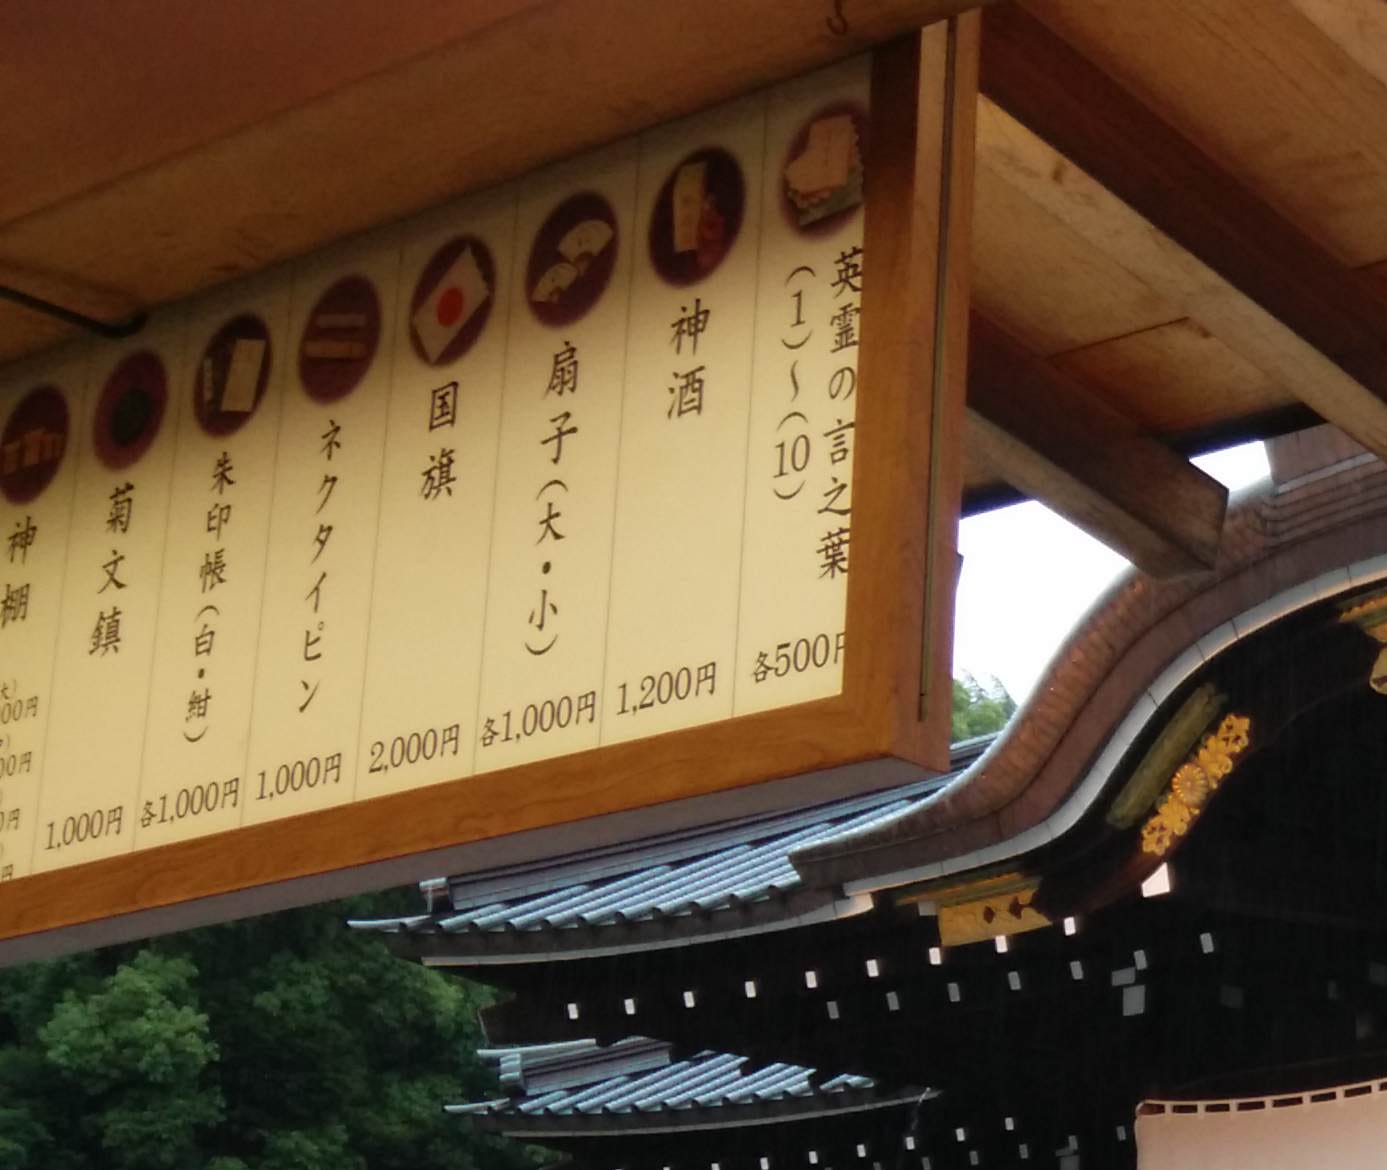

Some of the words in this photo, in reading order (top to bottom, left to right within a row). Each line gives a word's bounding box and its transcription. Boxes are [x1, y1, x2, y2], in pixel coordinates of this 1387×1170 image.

[667, 298, 710, 420] 神酒
[420, 381, 459, 500] 国旗
[1, 515, 38, 629] 神棚
[89, 482, 134, 657] 菊文鎮
[299, 419, 342, 713] ネクタイピン
[480, 689, 597, 750] 各1,000円
[616, 661, 717, 717] 1,200円
[256, 752, 343, 802] 1,000円
[369, 723, 461, 775] 2,000円
[140, 776, 240, 829] 各1,000円
